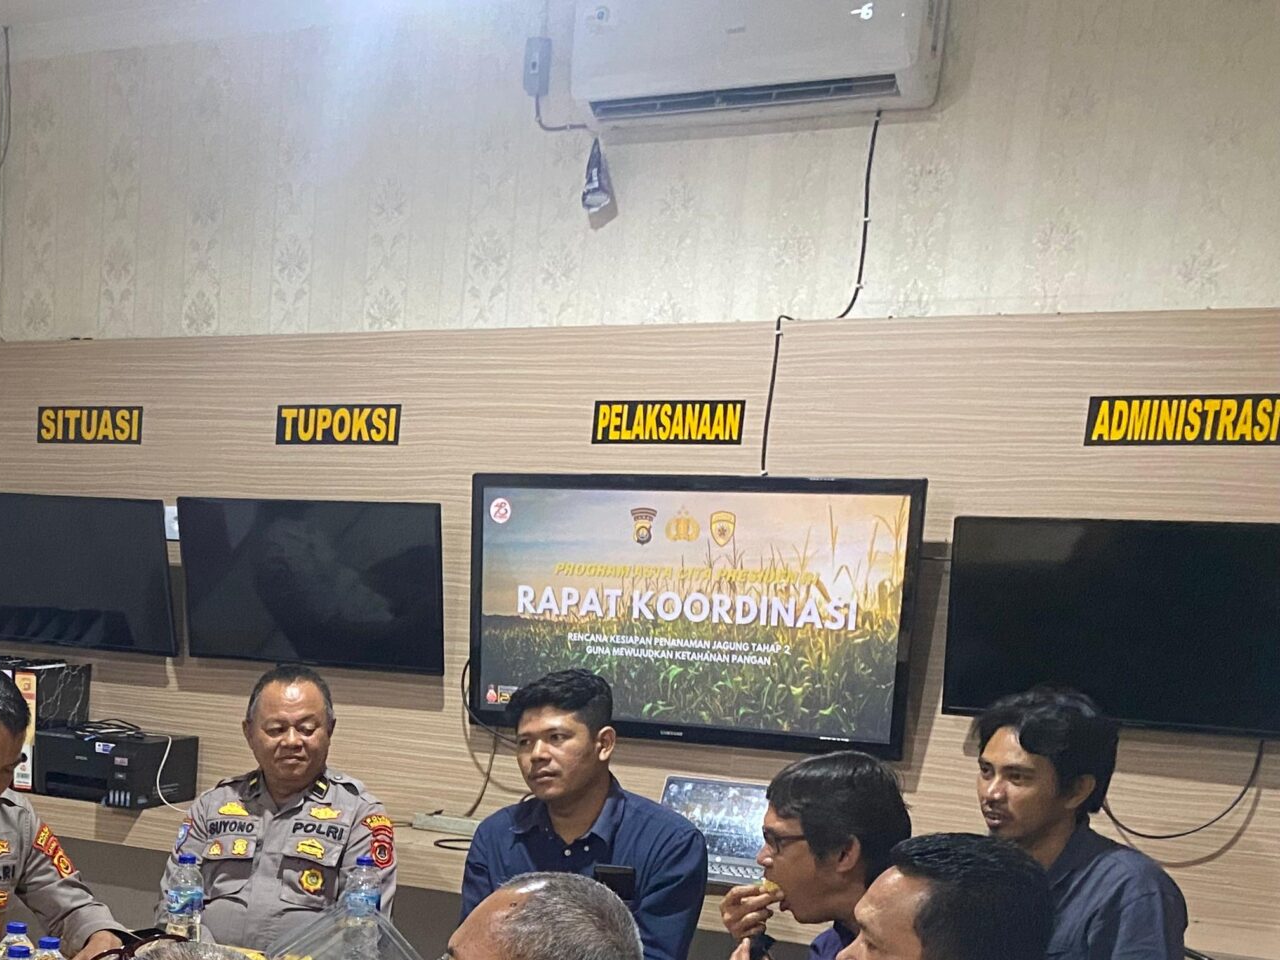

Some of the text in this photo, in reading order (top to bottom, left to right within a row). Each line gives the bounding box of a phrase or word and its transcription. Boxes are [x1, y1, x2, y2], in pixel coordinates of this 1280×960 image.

[40, 409, 139, 441] SITUASI
[281, 407, 397, 442] TUPOKSI
[596, 403, 742, 441] PELAKSANAAN
[1091, 398, 1280, 442] ADMINISTRASI
[554, 562, 630, 578] PROGRAM
[517, 585, 858, 631] RAPAT KOORDINASI
[567, 632, 791, 655] RENCANA KESIAPAN PENANAMAN JAGUNG TAHAP 2
[585, 645, 771, 666] GUNA MEWUJUDKAN KETAHANAN PANGAN
[208, 821, 255, 835] SUYONO
[292, 822, 344, 841] POLRI
